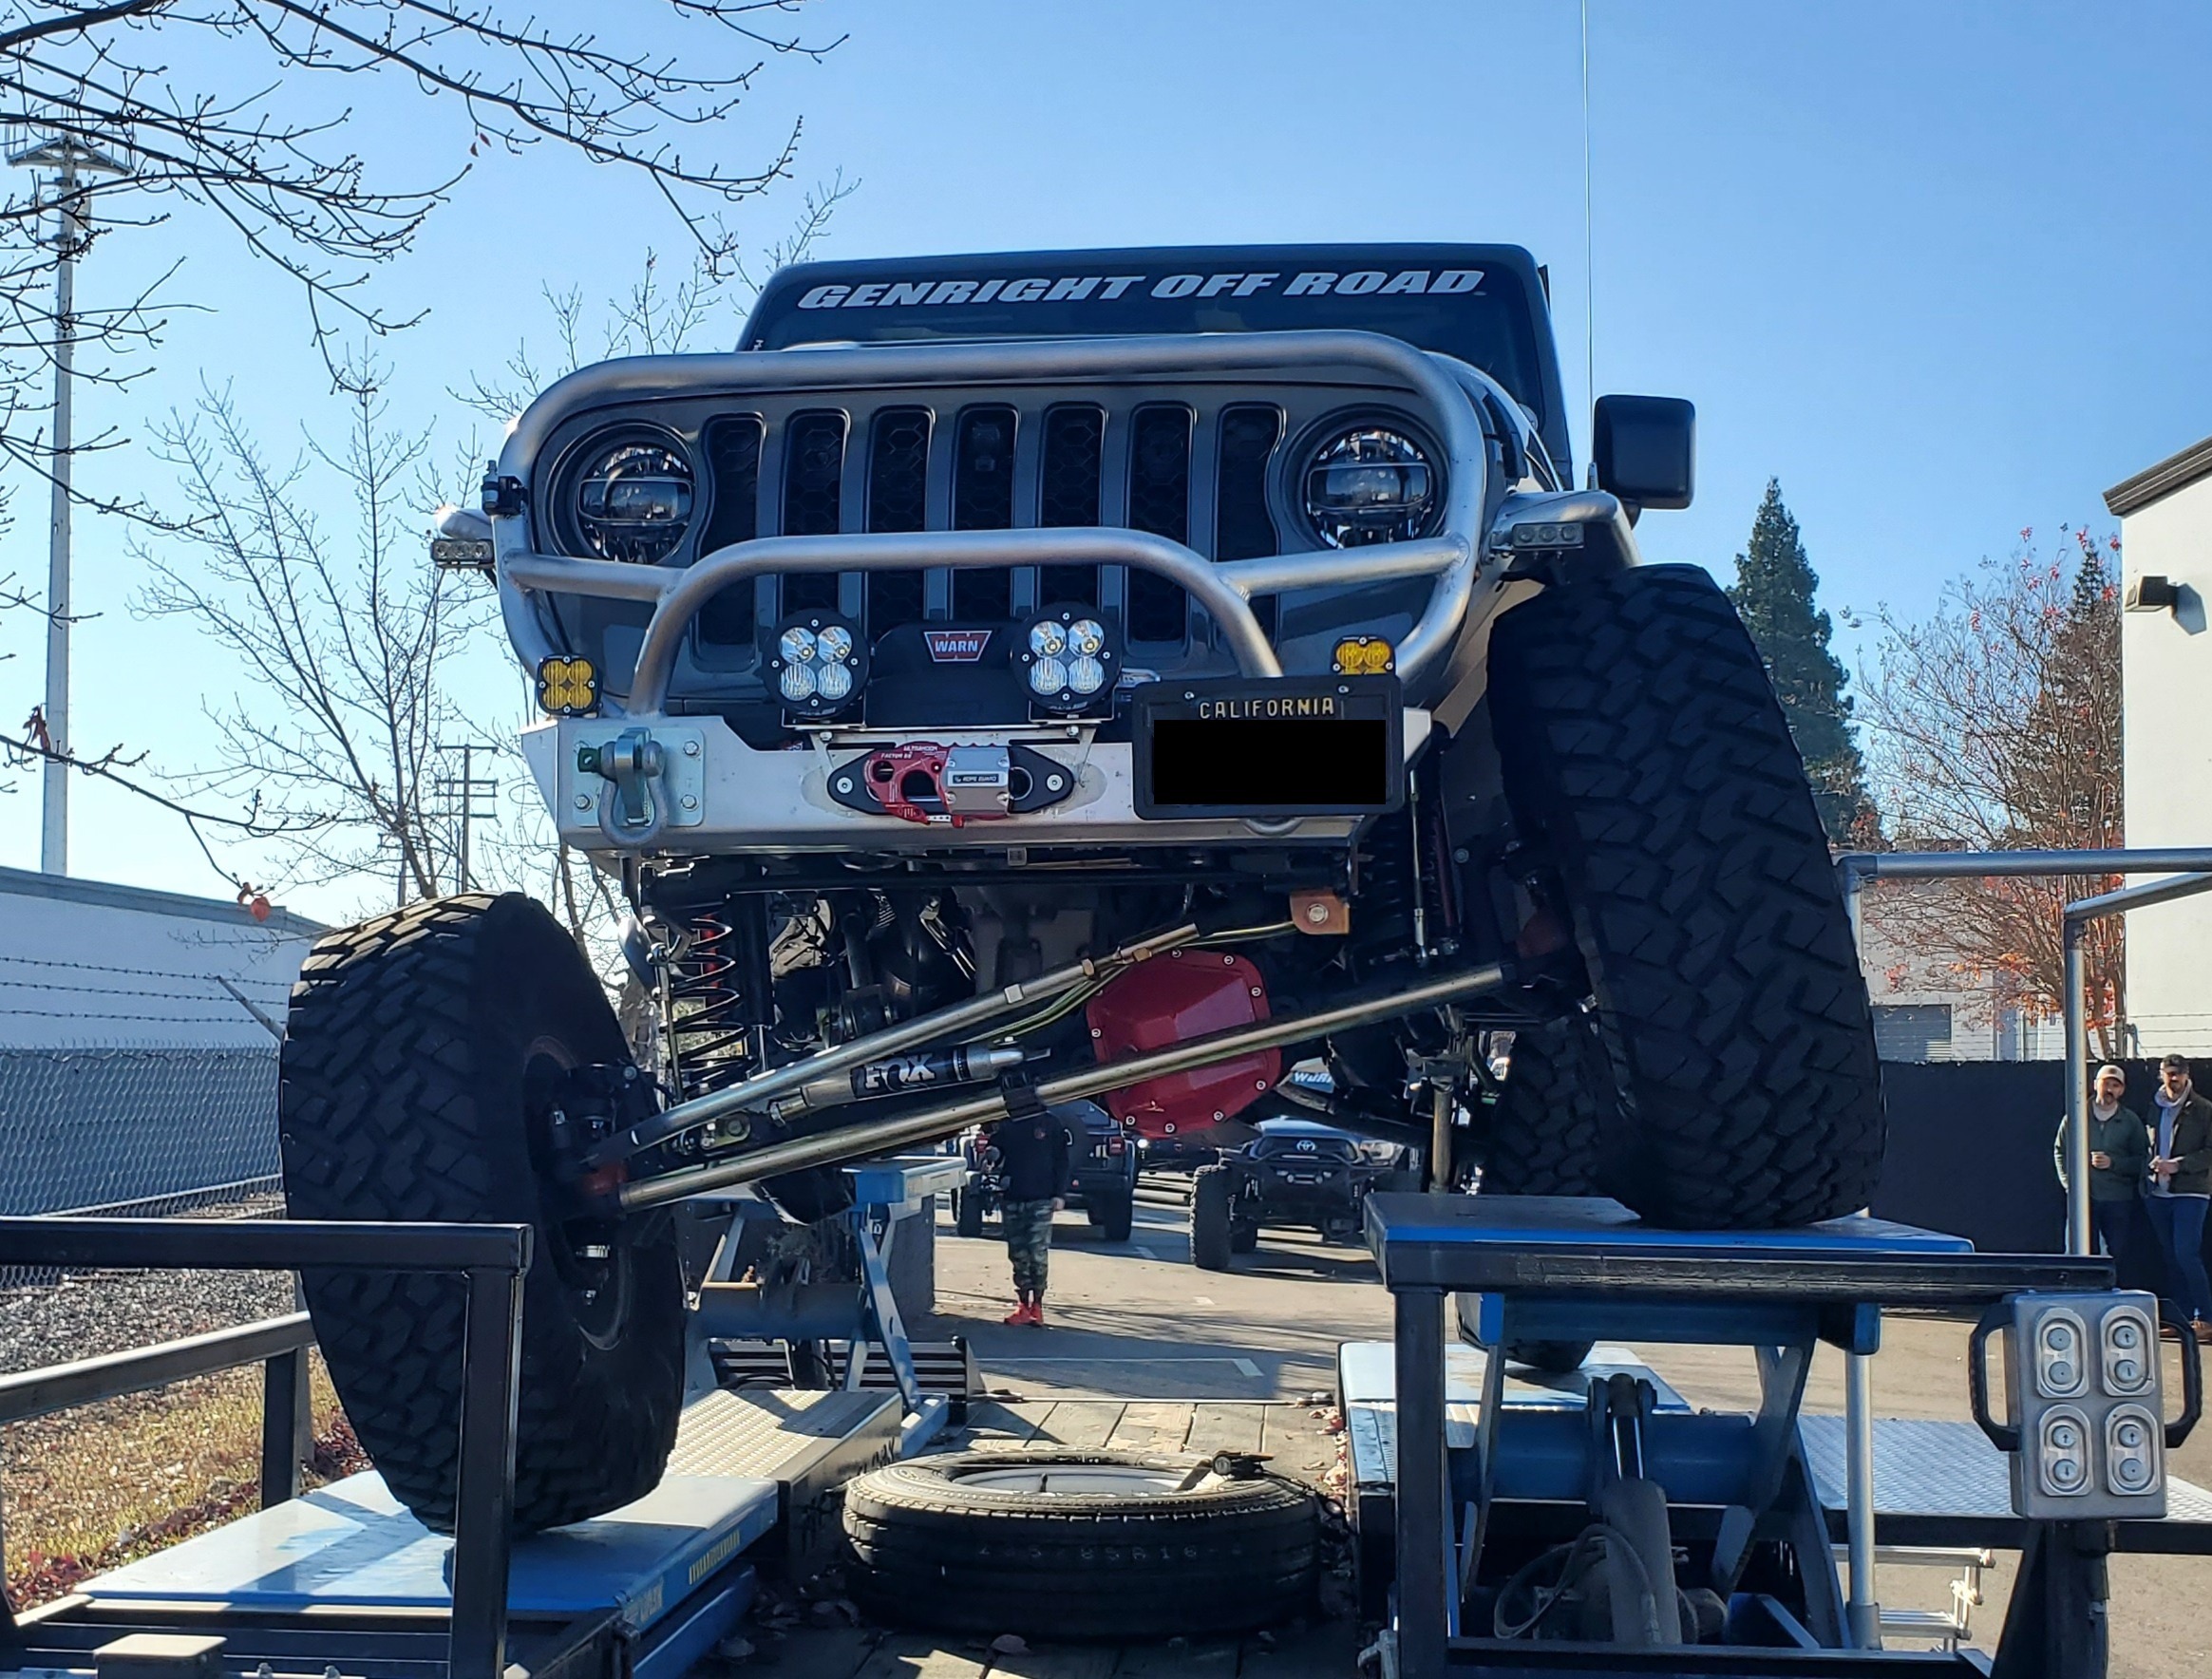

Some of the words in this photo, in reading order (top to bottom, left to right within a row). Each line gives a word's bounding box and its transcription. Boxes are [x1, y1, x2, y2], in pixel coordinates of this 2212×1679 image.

[797, 275, 1146, 310] GENRIGHT
[1150, 274, 1280, 298] OFF
[1282, 270, 1484, 295] ROAD
[935, 639, 978, 652] WARN
[1200, 696, 1335, 720] CALIFORNIA
[864, 1052, 936, 1091] FOX
